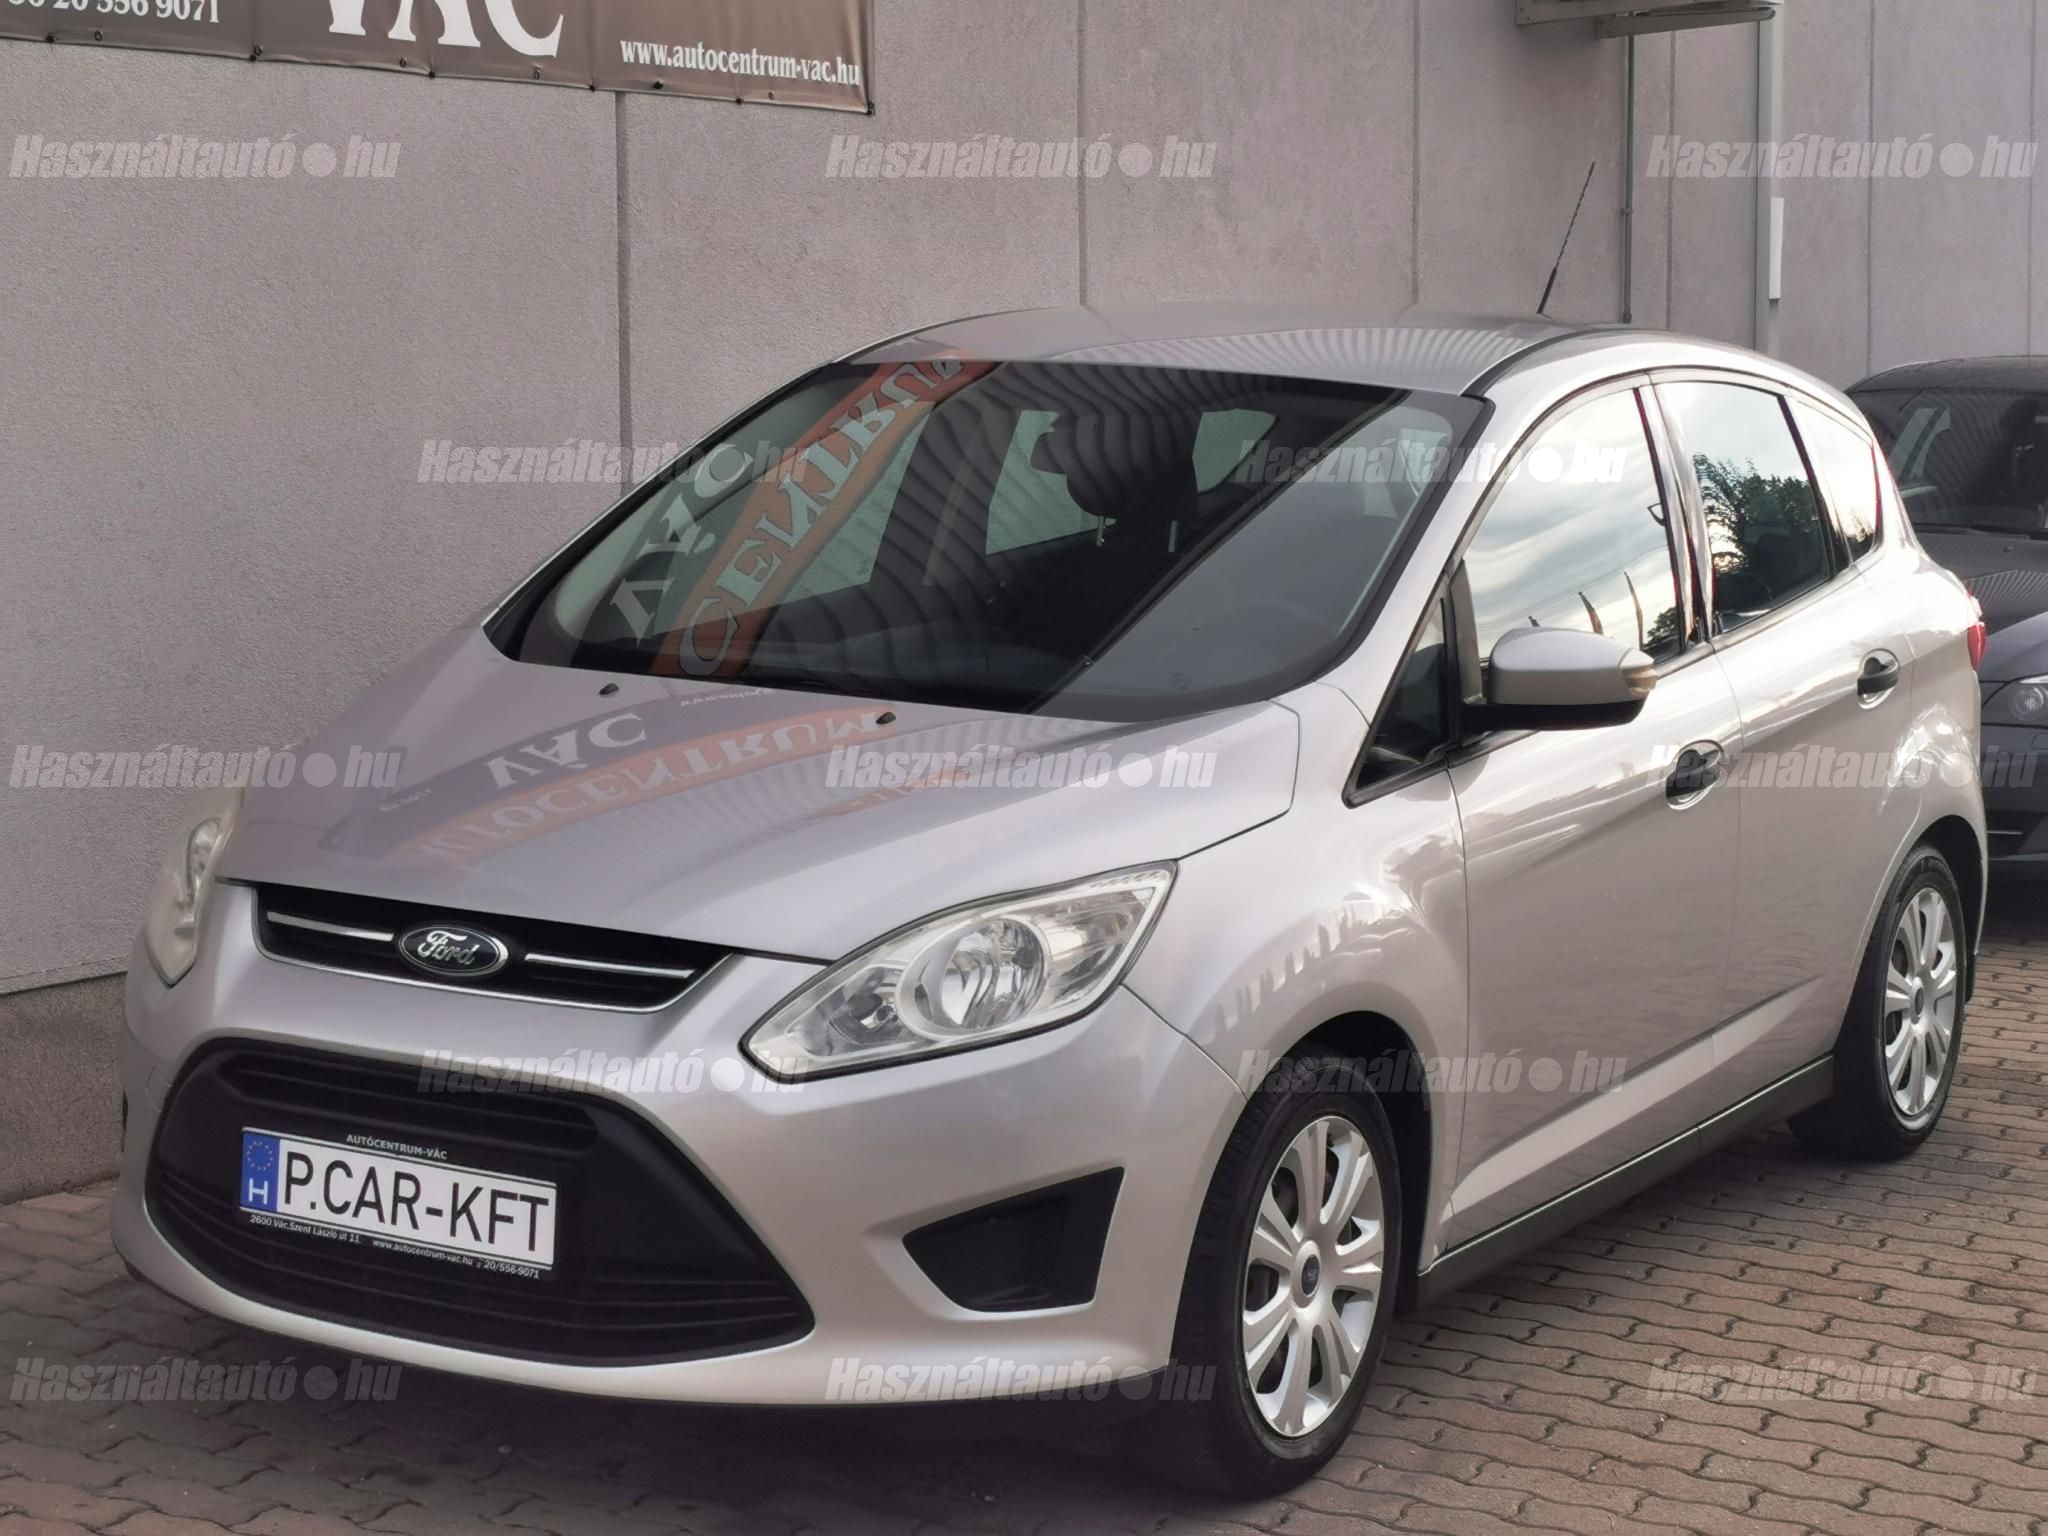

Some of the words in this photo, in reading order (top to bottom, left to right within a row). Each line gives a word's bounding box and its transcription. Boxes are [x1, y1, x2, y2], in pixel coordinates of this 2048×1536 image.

[619, 40, 861, 86] www.autocentrum-vac.hu
[417, 930, 480, 965] Ford
[346, 1133, 448, 1160] AUTÓCENTRUM-VÁC
[249, 1178, 268, 1205] H
[283, 1151, 549, 1252] P.CAR-KFT
[372, 1239, 473, 1266] www.autocentrum-vac.hu
